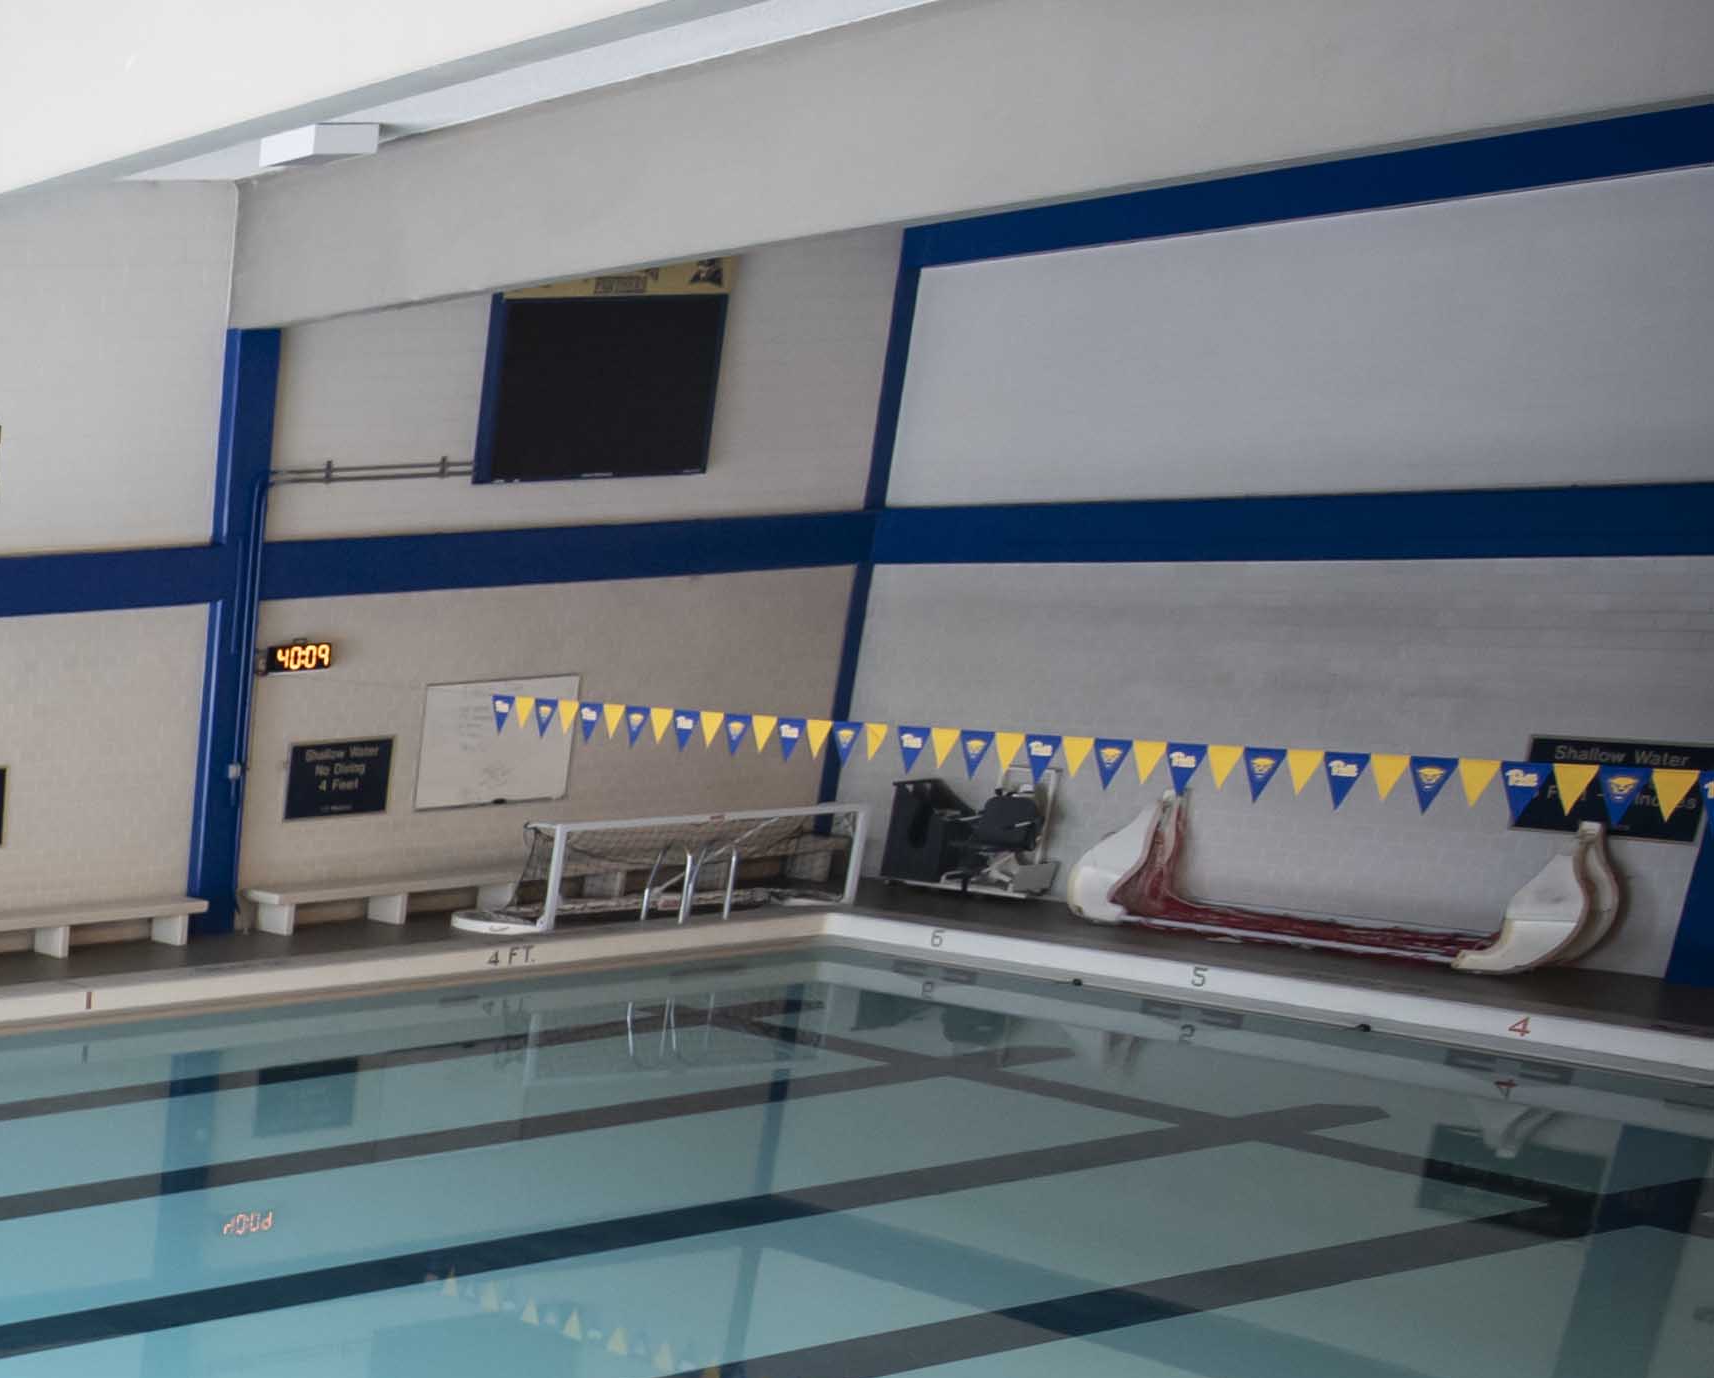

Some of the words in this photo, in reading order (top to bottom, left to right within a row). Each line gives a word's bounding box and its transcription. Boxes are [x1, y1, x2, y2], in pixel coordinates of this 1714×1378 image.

[276, 643, 331, 671] 40:09
[1554, 745, 1627, 764] Shallow
[1634, 750, 1691, 767] Water
[1635, 792, 1697, 809] Inces
[931, 929, 943, 948] 6
[487, 950, 499, 966] 4
[508, 945, 536, 965] FT.
[1191, 967, 1207, 988] 5
[1508, 1017, 1531, 1037] 4
